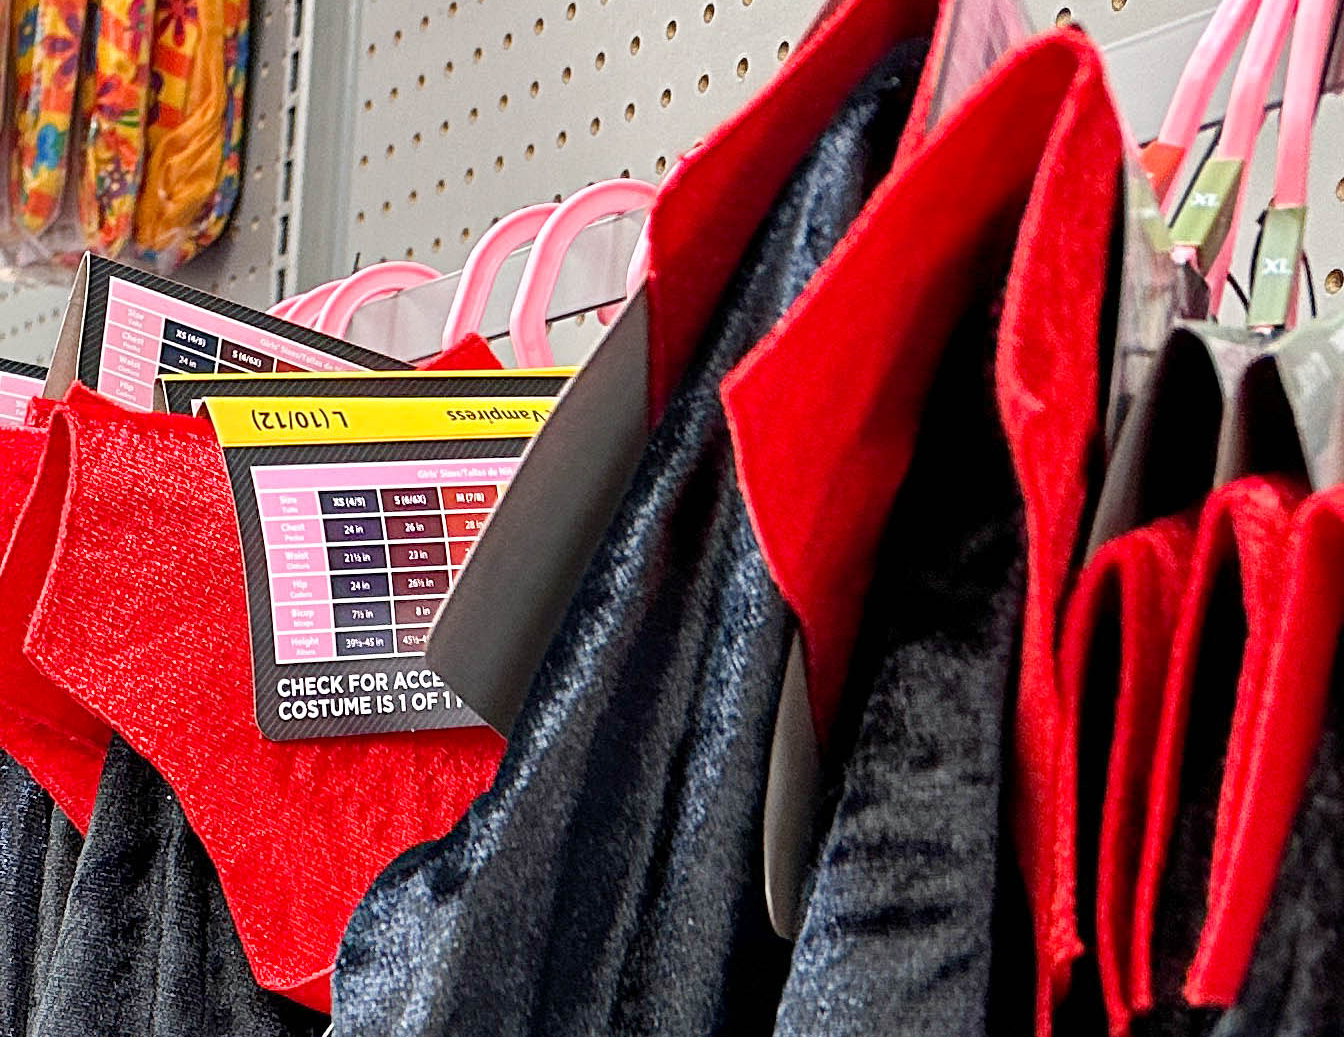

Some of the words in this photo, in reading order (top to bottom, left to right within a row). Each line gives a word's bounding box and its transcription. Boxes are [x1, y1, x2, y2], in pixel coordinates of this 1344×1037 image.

[1262, 258, 1292, 275] XL
[251, 408, 330, 431] (10/12)
[332, 411, 348, 428] L
[446, 406, 548, 424] Vampiress
[344, 525, 355, 535] 24
[350, 582, 361, 592] 24
[276, 673, 344, 698] CHECK
[348, 671, 389, 693] FOR
[278, 697, 372, 721] COSTUME
[376, 693, 395, 714] IS
[397, 693, 407, 712] 1
[411, 690, 439, 712] OF
[442, 690, 451, 709] 1
